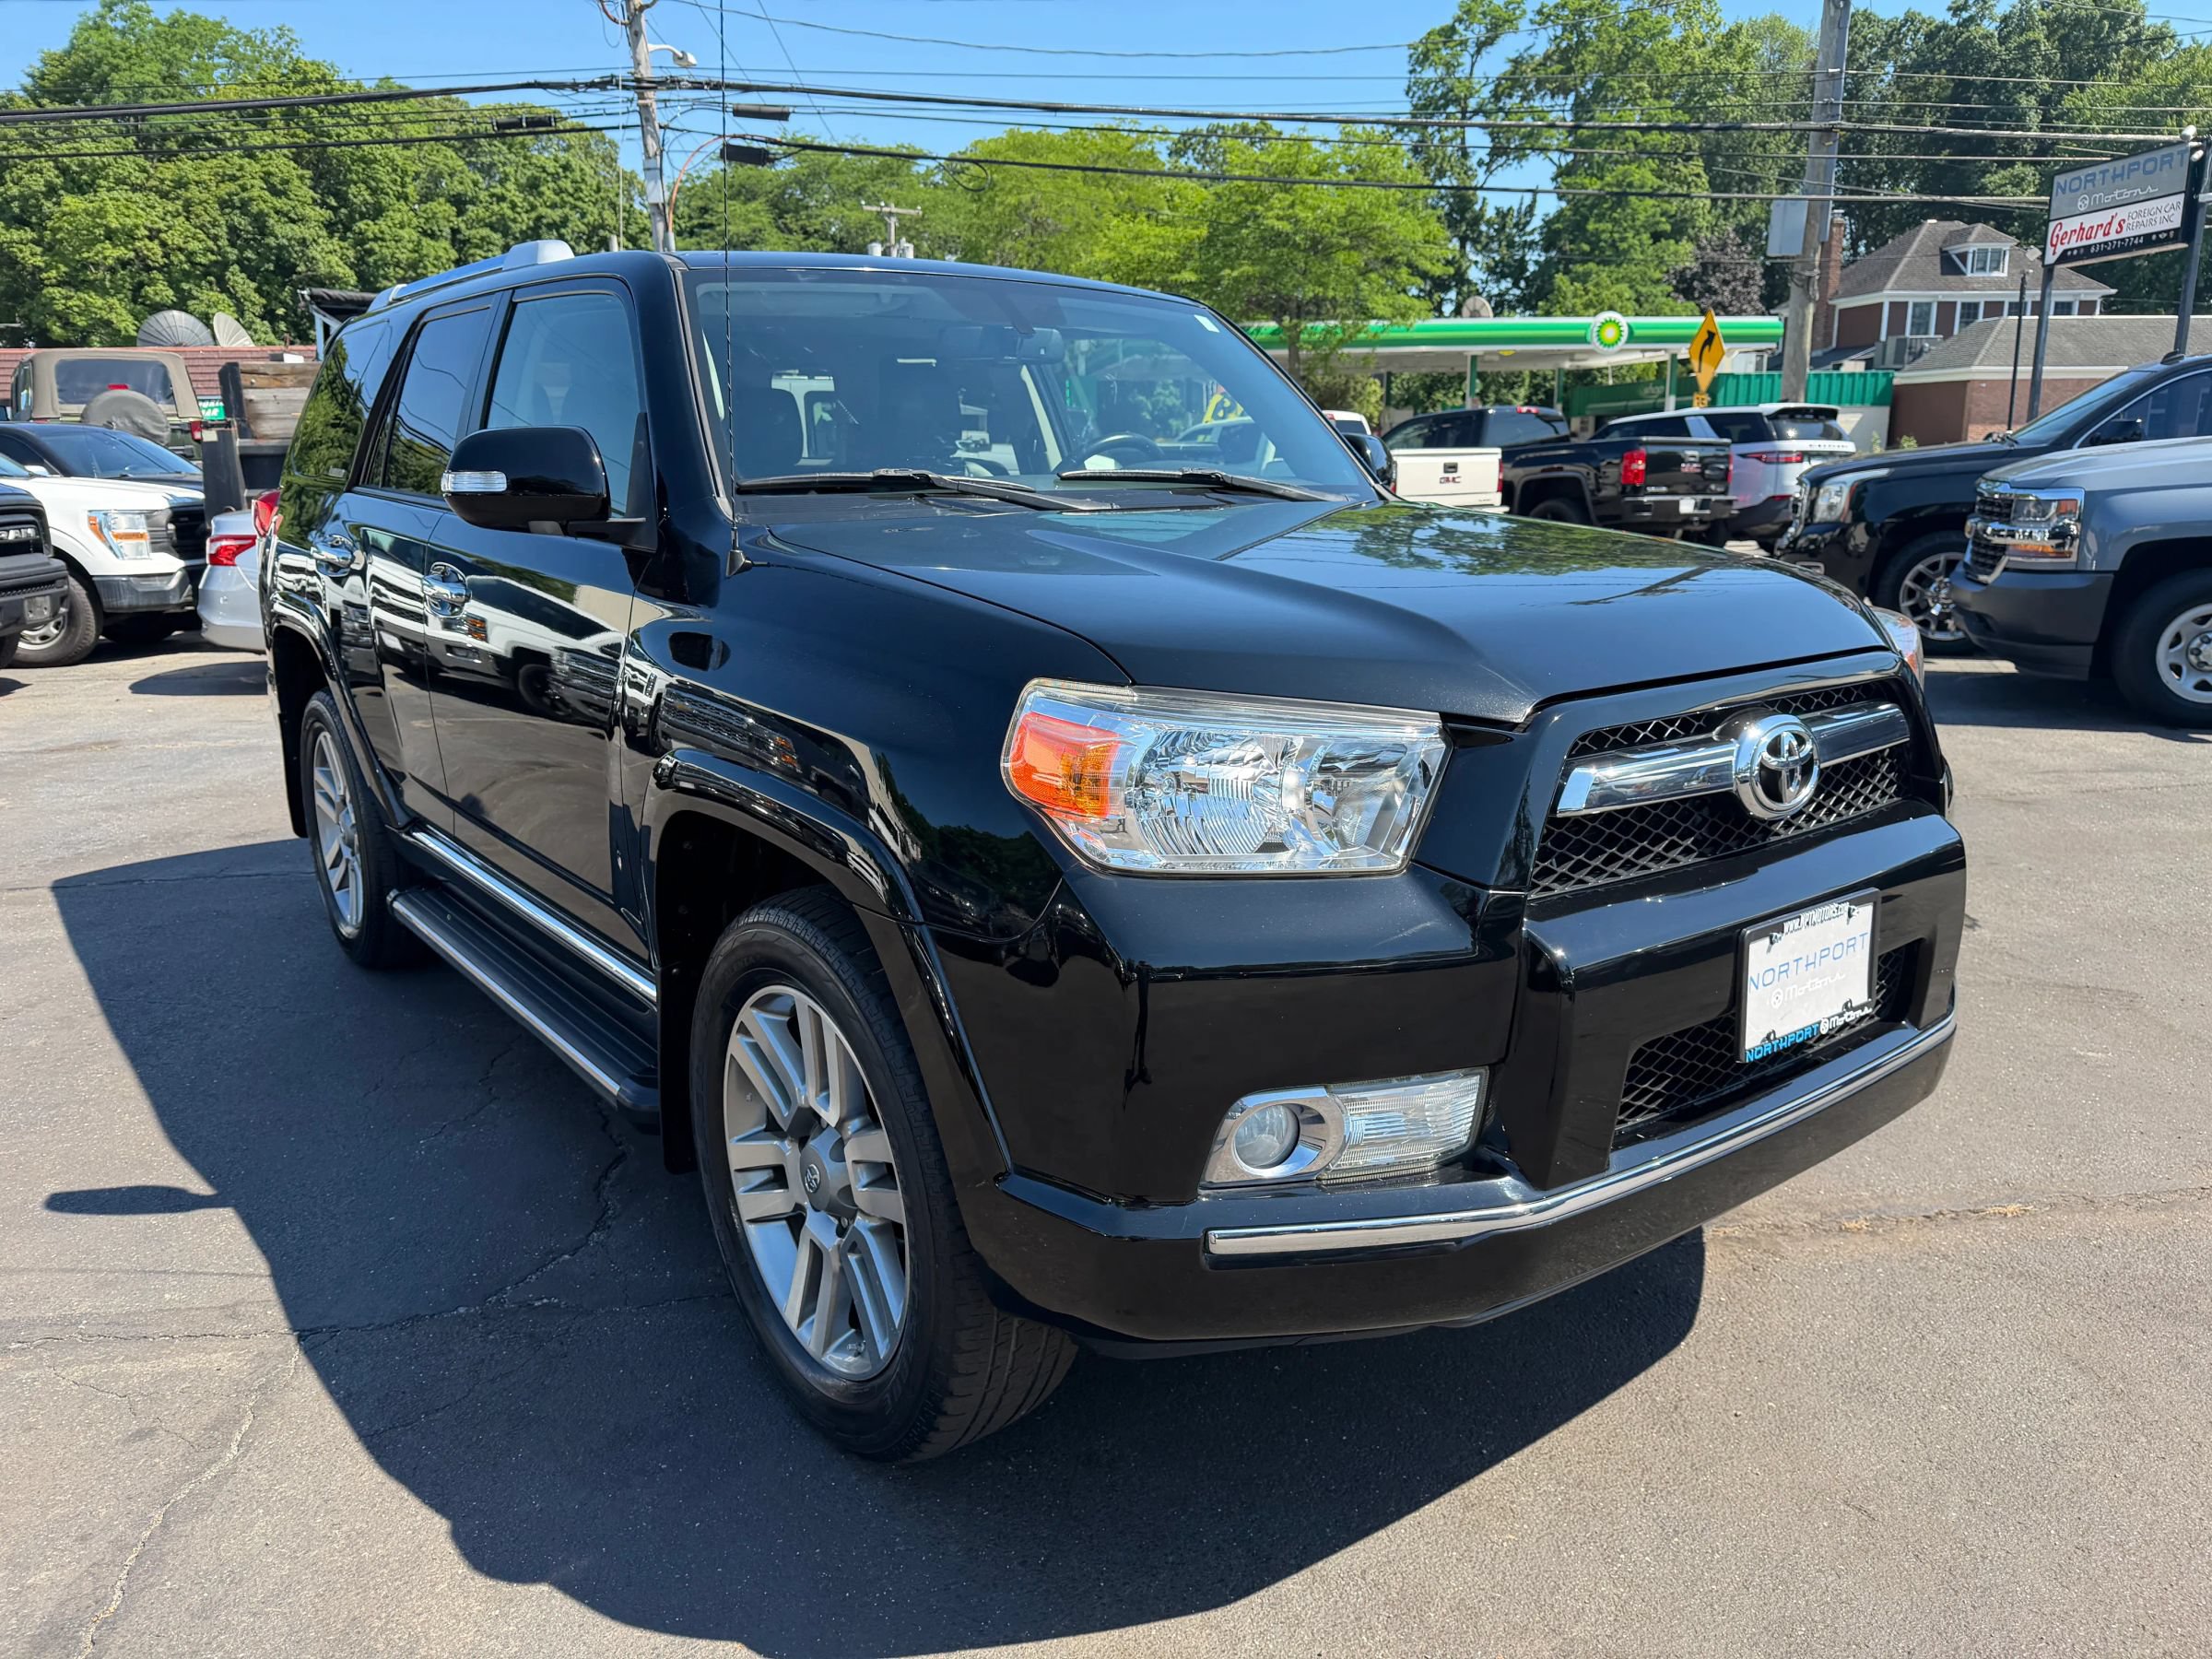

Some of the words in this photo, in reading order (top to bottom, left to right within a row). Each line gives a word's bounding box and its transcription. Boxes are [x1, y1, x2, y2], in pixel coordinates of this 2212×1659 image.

[2056, 148, 2190, 196] NORTHPORT
[2090, 185, 2159, 206] Motors
[2125, 216, 2158, 231] REPAIRS
[2159, 214, 2175, 226] INC
[2127, 206, 2164, 221] FOREIGN
[2163, 201, 2182, 214] CAR
[2050, 212, 2126, 255] Gerhard's
[2089, 236, 2144, 253] 631-271-7744
[1749, 933, 1868, 992] NORTHPORT
[1746, 1024, 1819, 1062] NORTHPORT
